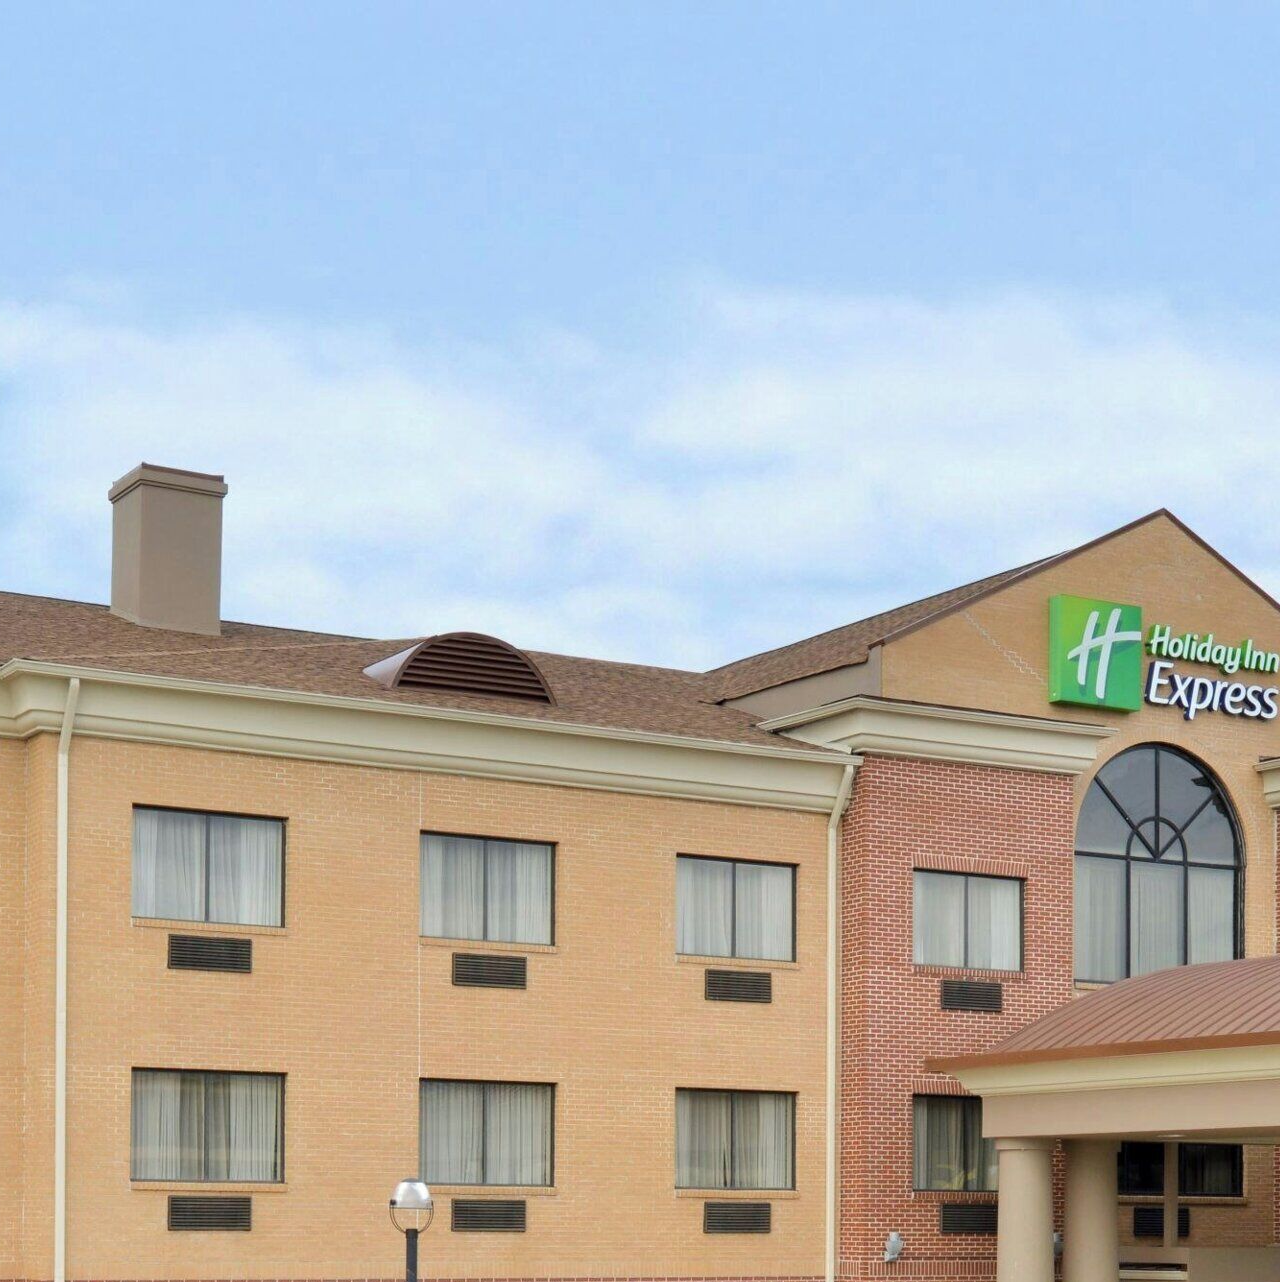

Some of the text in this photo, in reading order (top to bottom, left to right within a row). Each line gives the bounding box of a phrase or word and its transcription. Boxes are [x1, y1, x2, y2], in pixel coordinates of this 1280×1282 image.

[1148, 624, 1280, 674] Holiday Inn
[1146, 660, 1280, 721] Express
